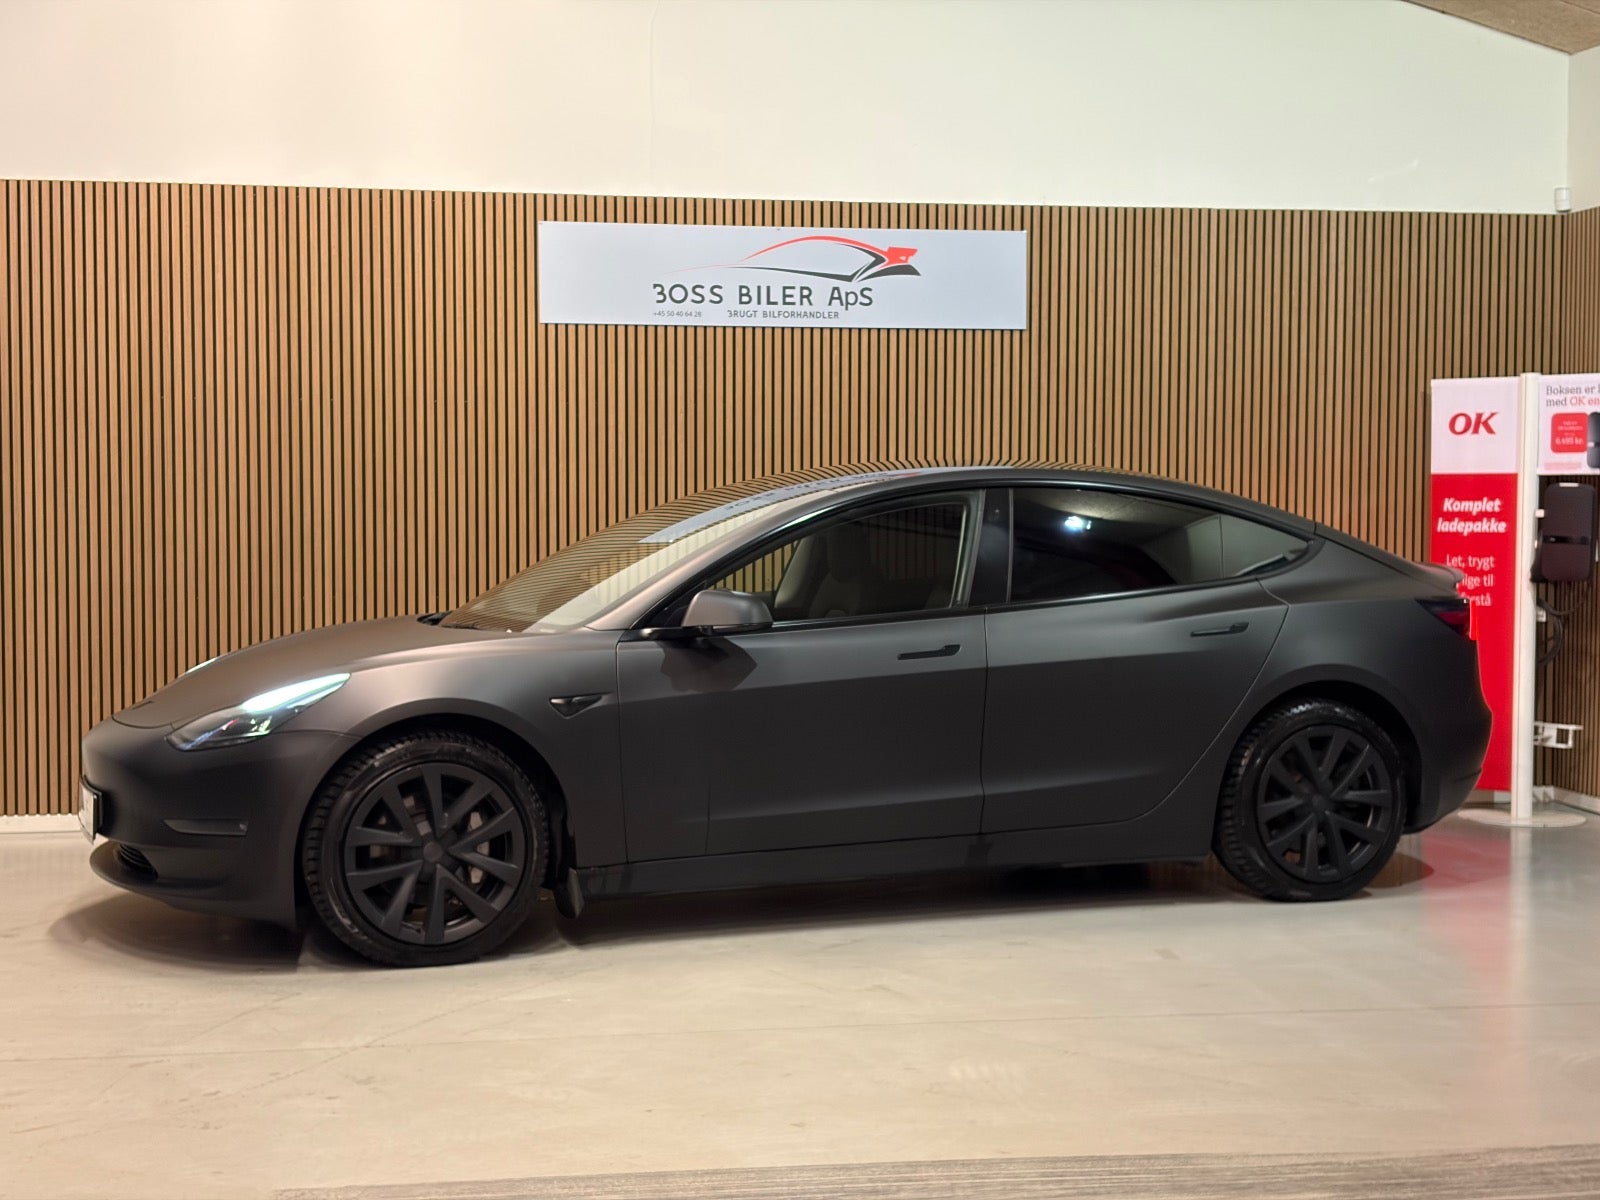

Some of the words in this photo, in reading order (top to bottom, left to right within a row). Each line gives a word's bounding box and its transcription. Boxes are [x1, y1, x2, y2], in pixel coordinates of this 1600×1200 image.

[738, 285, 813, 306] BILER
[827, 286, 874, 311] ApS
[762, 310, 840, 319] BILFORHANDLER
[1546, 385, 1582, 396] Boksen
[1584, 386, 1596, 395] er
[1546, 396, 1567, 407] med
[1570, 395, 1586, 406] OK
[1448, 411, 1499, 435] OK
[1443, 497, 1501, 516] Komplet
[1437, 518, 1507, 536] ladepakke
[1446, 553, 1465, 569] Let,
[1468, 554, 1495, 571] trygt
[1483, 573, 1494, 587] til
